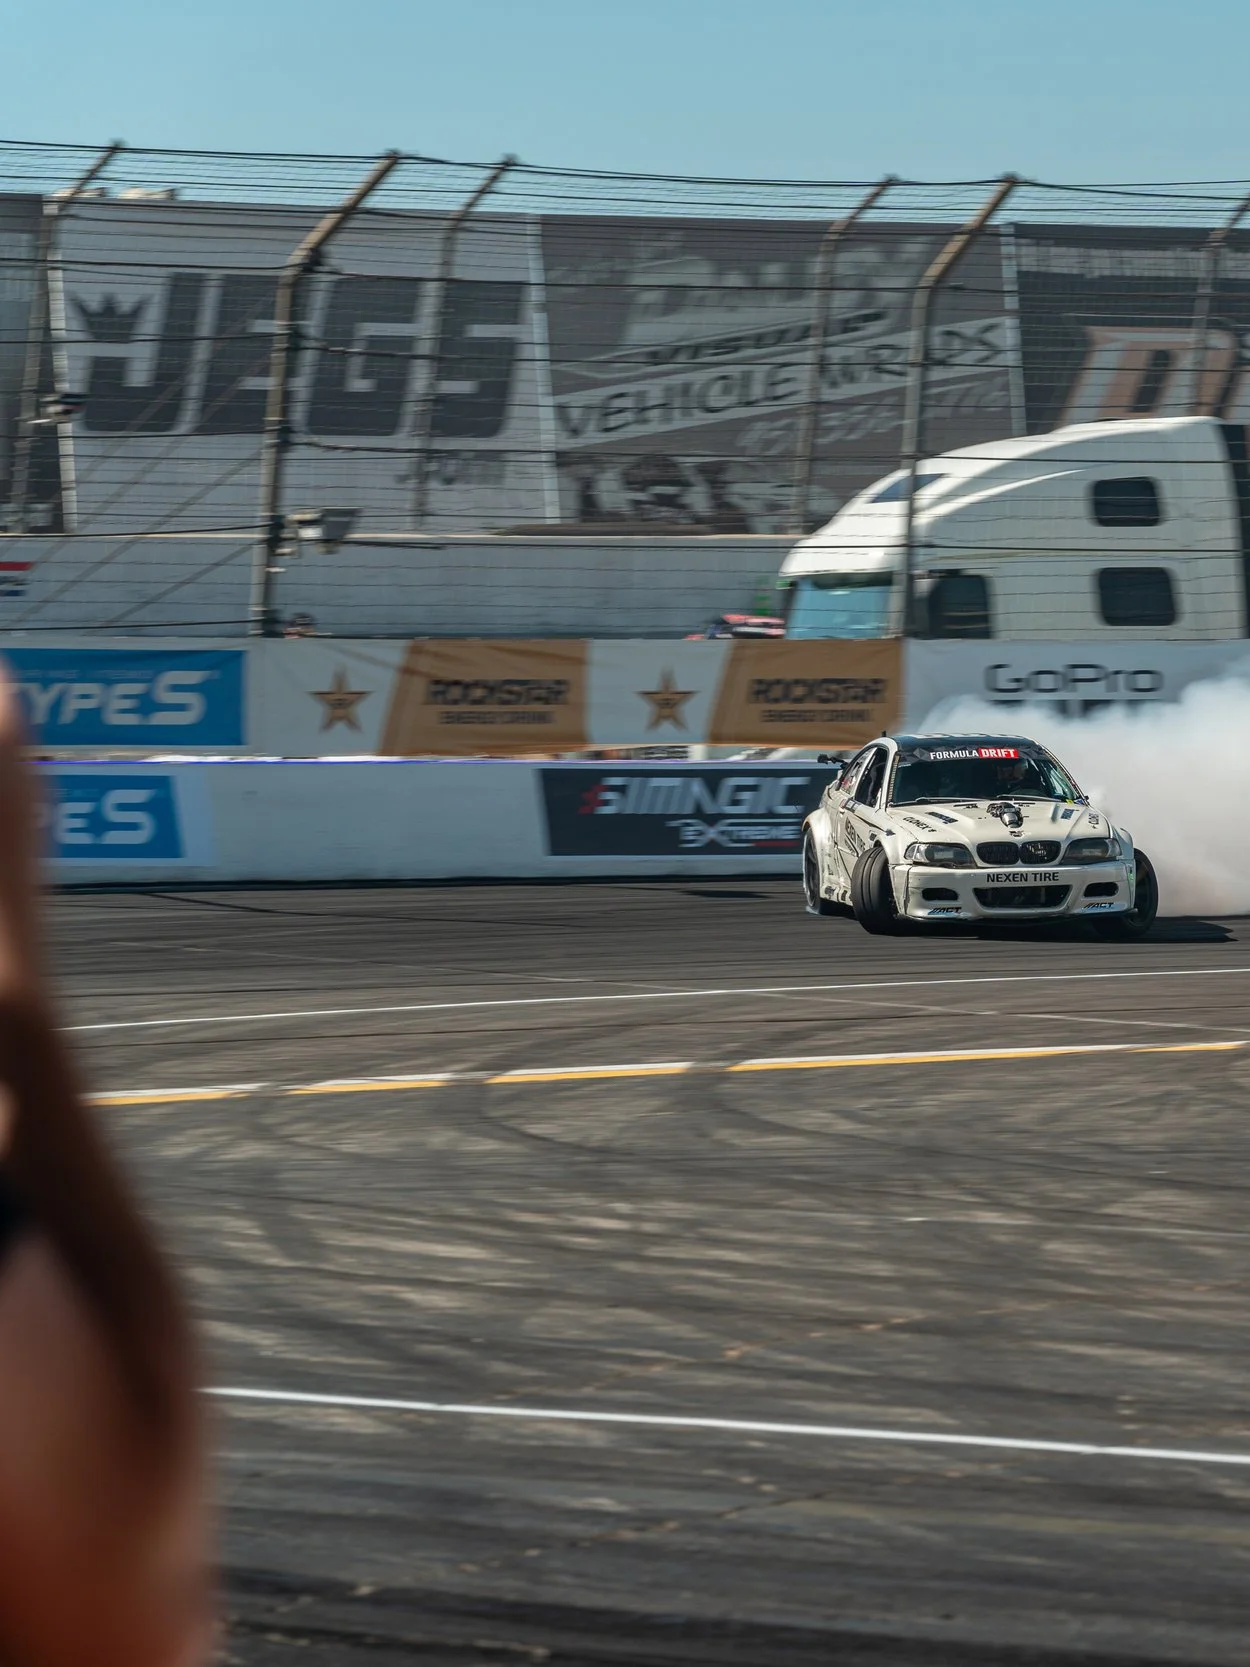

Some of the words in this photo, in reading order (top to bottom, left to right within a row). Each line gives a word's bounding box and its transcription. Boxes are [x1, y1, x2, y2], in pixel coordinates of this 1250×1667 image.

[555, 361, 800, 437] VEHICLE
[985, 663, 1164, 693] GoPro
[930, 750, 979, 760] FORMULA
[981, 748, 1015, 758] DRIFT
[986, 873, 1028, 882] NEXEN
[1031, 872, 1059, 881] TIRE
